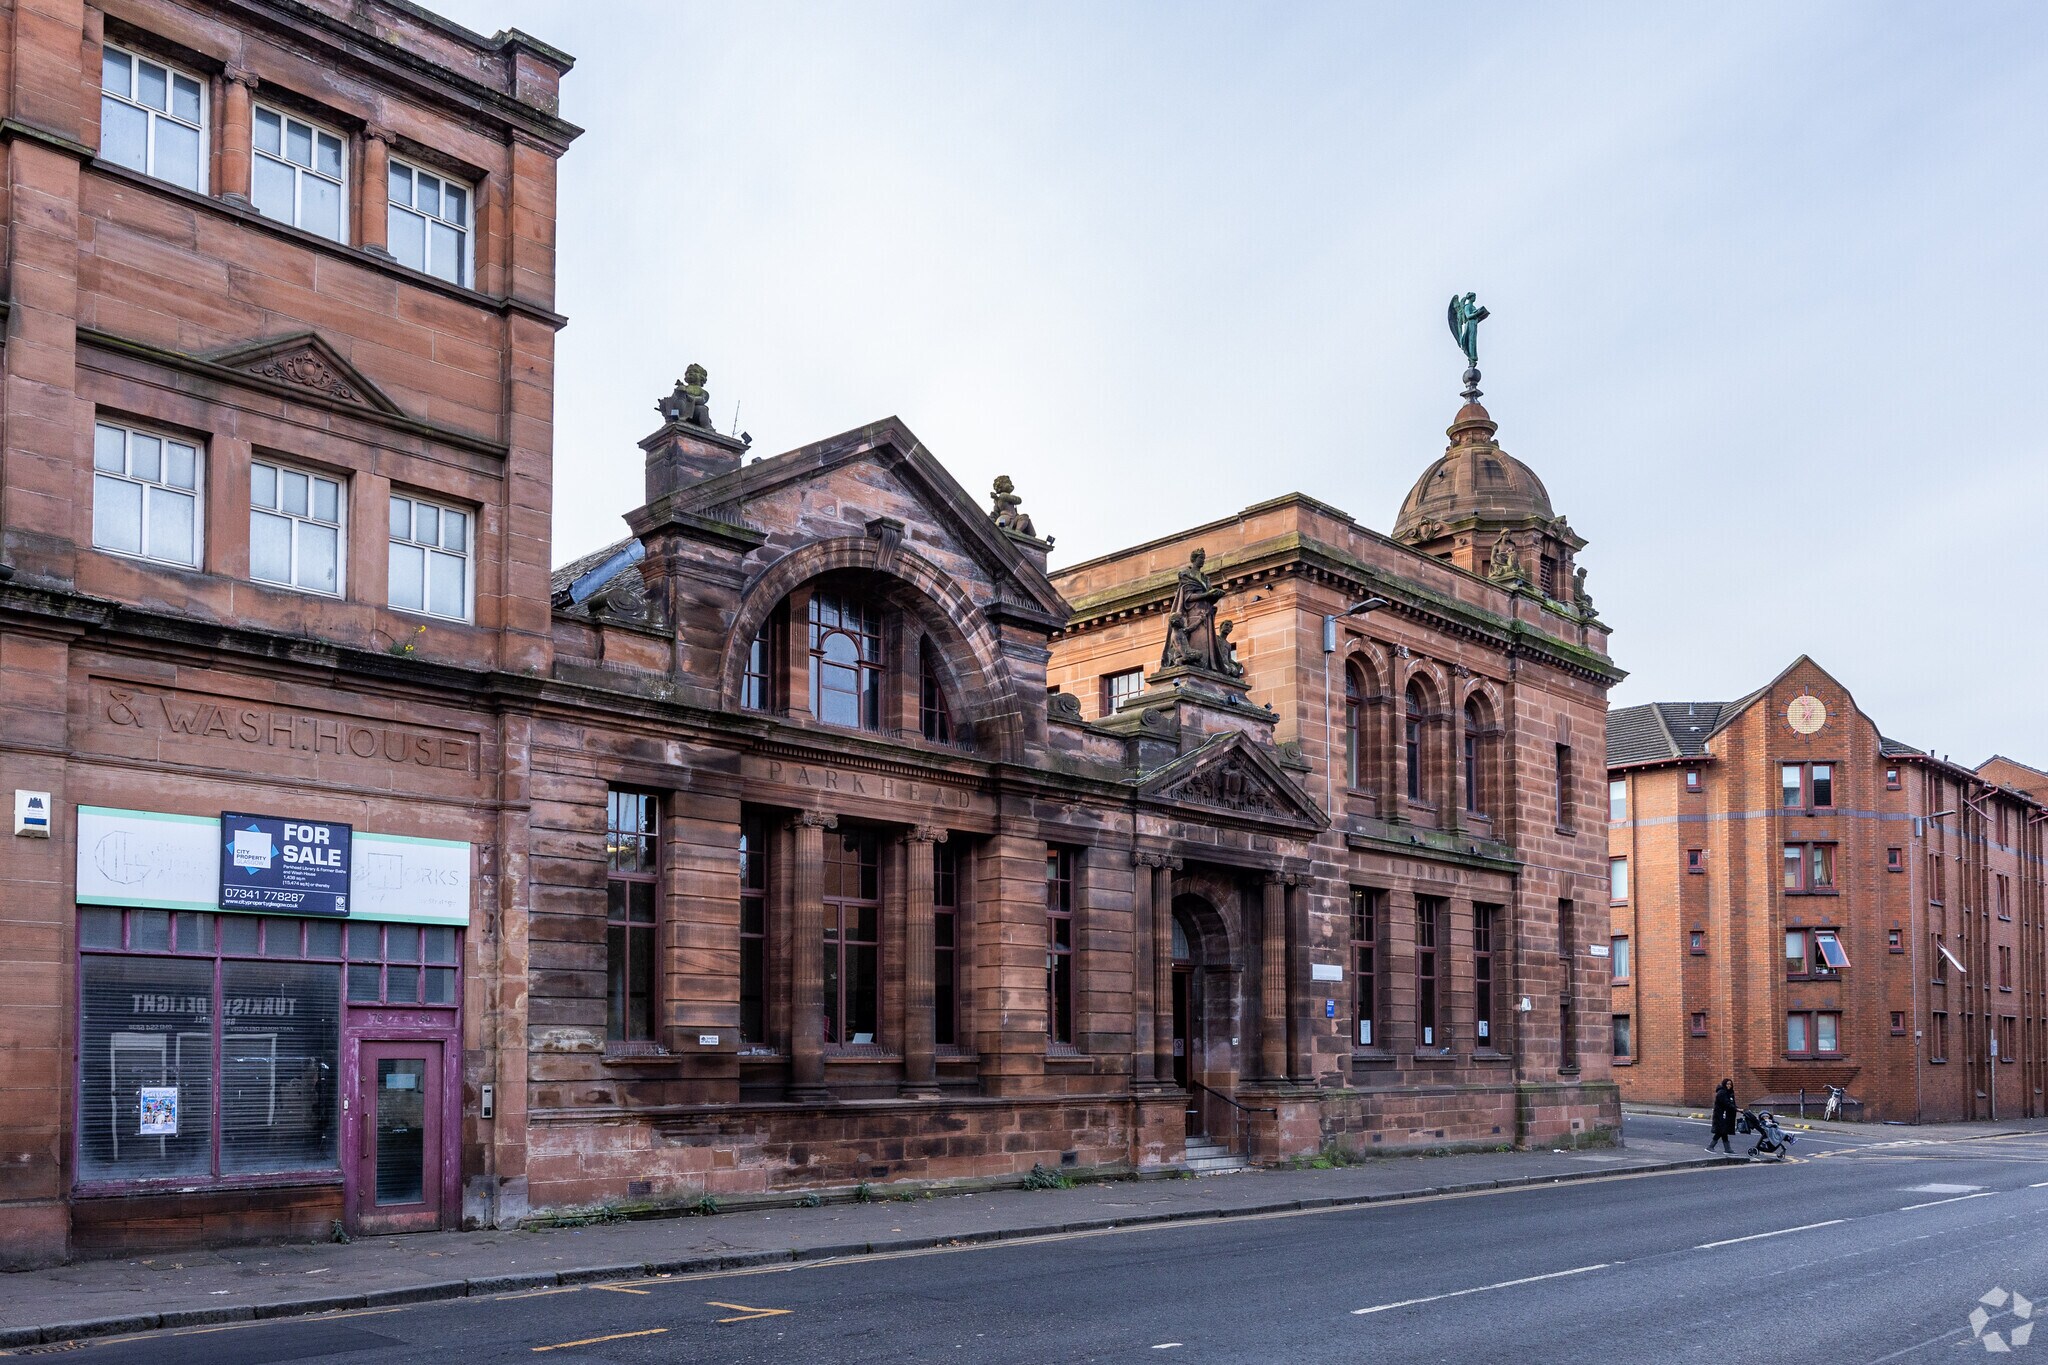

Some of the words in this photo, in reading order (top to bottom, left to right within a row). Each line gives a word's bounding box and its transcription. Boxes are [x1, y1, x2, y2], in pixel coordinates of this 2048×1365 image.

[107, 689, 143, 728] &
[768, 760, 970, 808] PARKHEAD
[283, 823, 330, 845] FOR
[283, 844, 341, 867] SALE
[1392, 860, 1470, 884] LIBRARY
[225, 888, 260, 900] 07341
[263, 891, 305, 902] 778287
